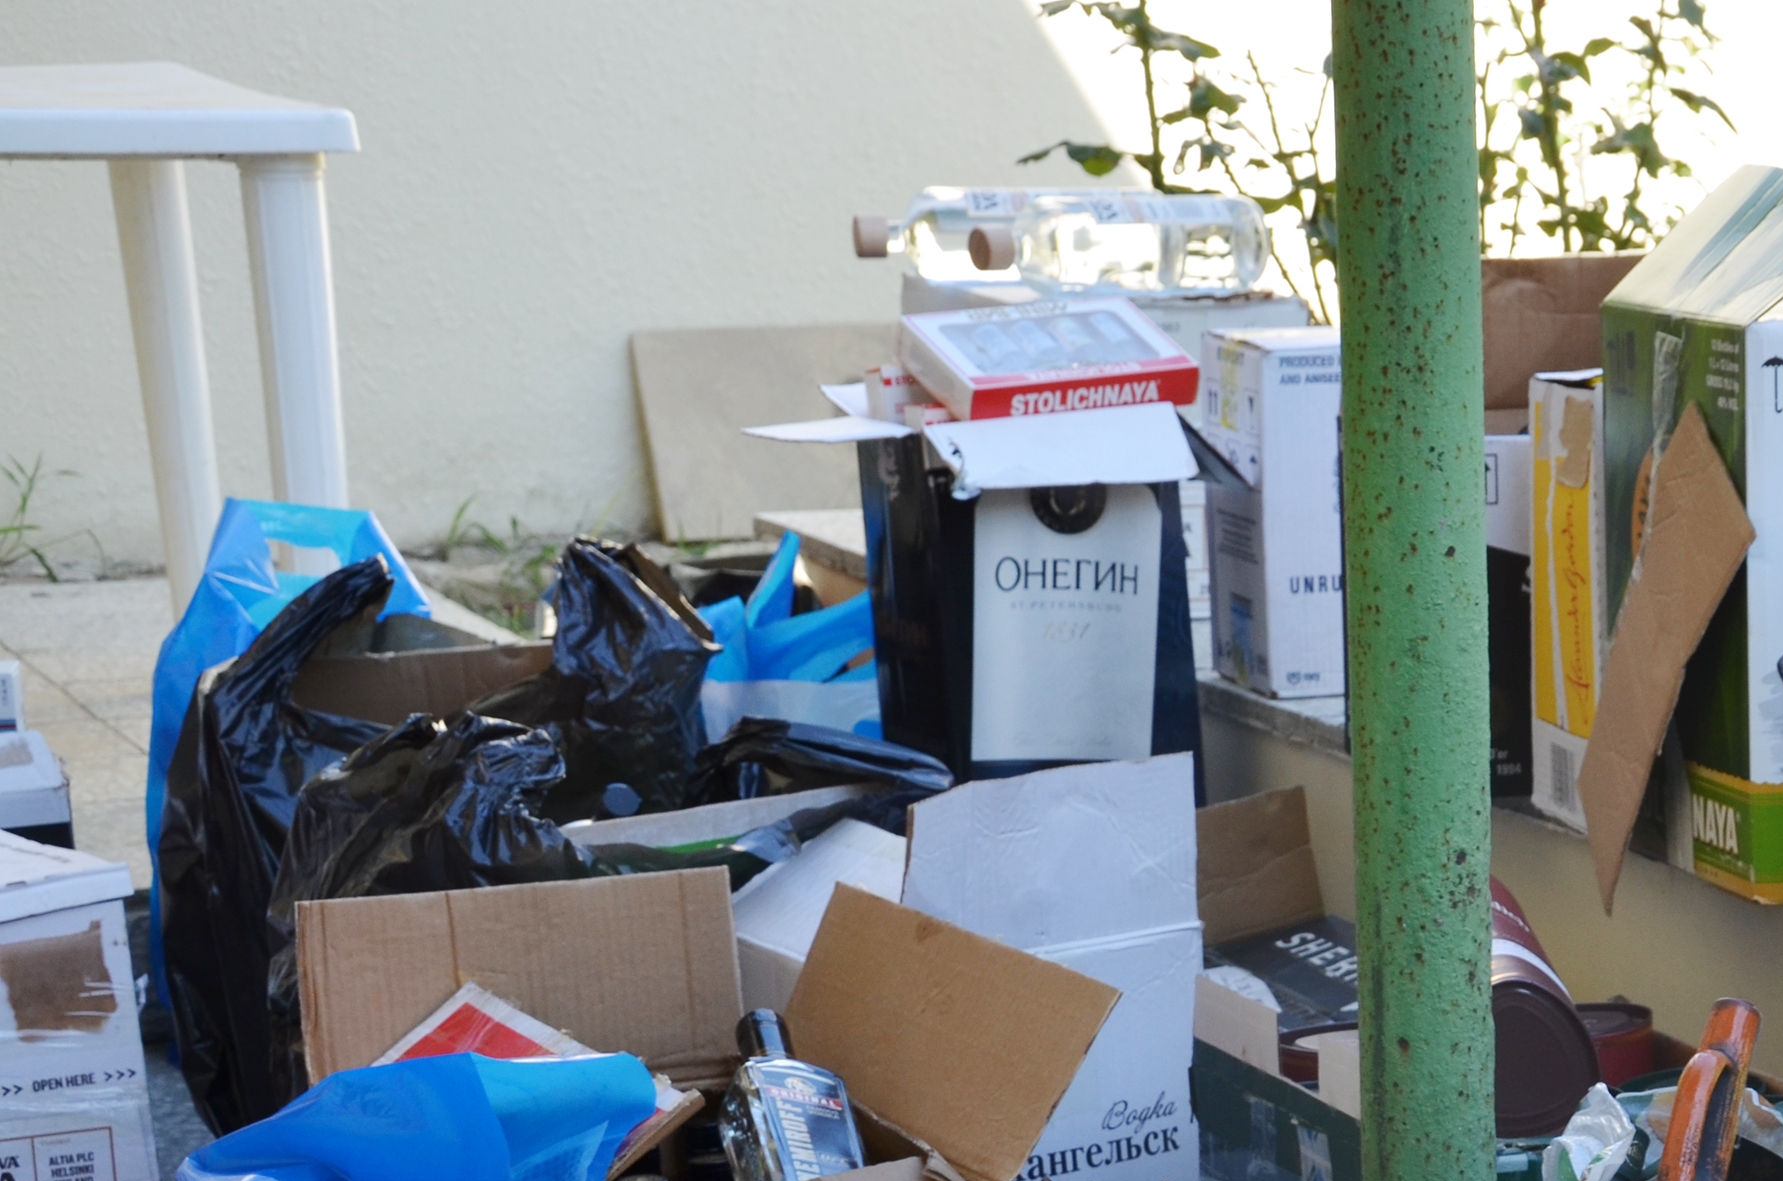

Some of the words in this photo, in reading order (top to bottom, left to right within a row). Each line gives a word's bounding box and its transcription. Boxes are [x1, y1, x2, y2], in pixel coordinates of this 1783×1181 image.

[1279, 355, 1335, 368] PRODUCED
[1279, 374, 1301, 385] AND
[1011, 380, 1159, 416] STOLICHNAYA
[995, 556, 1139, 595] ОНЕГИН
[1289, 575, 1342, 594] UNRU
[32, 1077, 63, 1093] OPEN
[66, 1072, 96, 1087] HERE
[49, 1153, 75, 1166] ALTIA
[76, 1151, 95, 1163] PLC
[51, 1164, 95, 1178] HELSINKI
